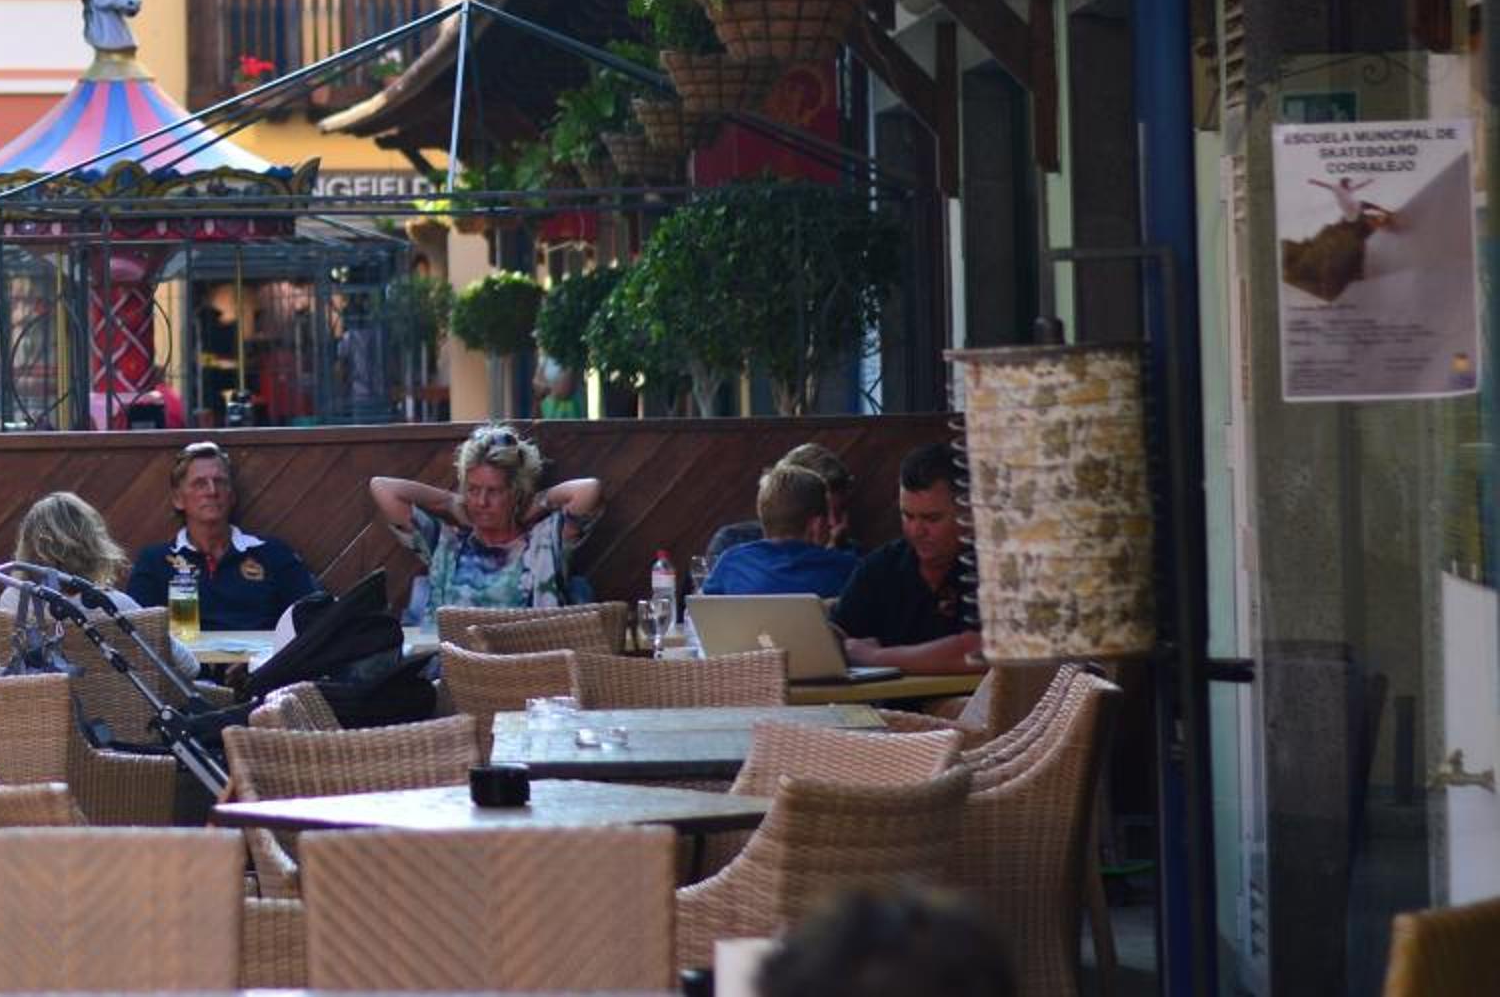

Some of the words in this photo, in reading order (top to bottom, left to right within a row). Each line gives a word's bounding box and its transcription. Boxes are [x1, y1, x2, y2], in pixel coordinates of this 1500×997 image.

[1284, 132, 1349, 145] ESCUELA
[1355, 128, 1432, 142] MUNICIPAL
[1436, 128, 1458, 140] DE
[1319, 144, 1418, 159] SKATEBOARD
[1325, 160, 1416, 173] CORRALEJO
